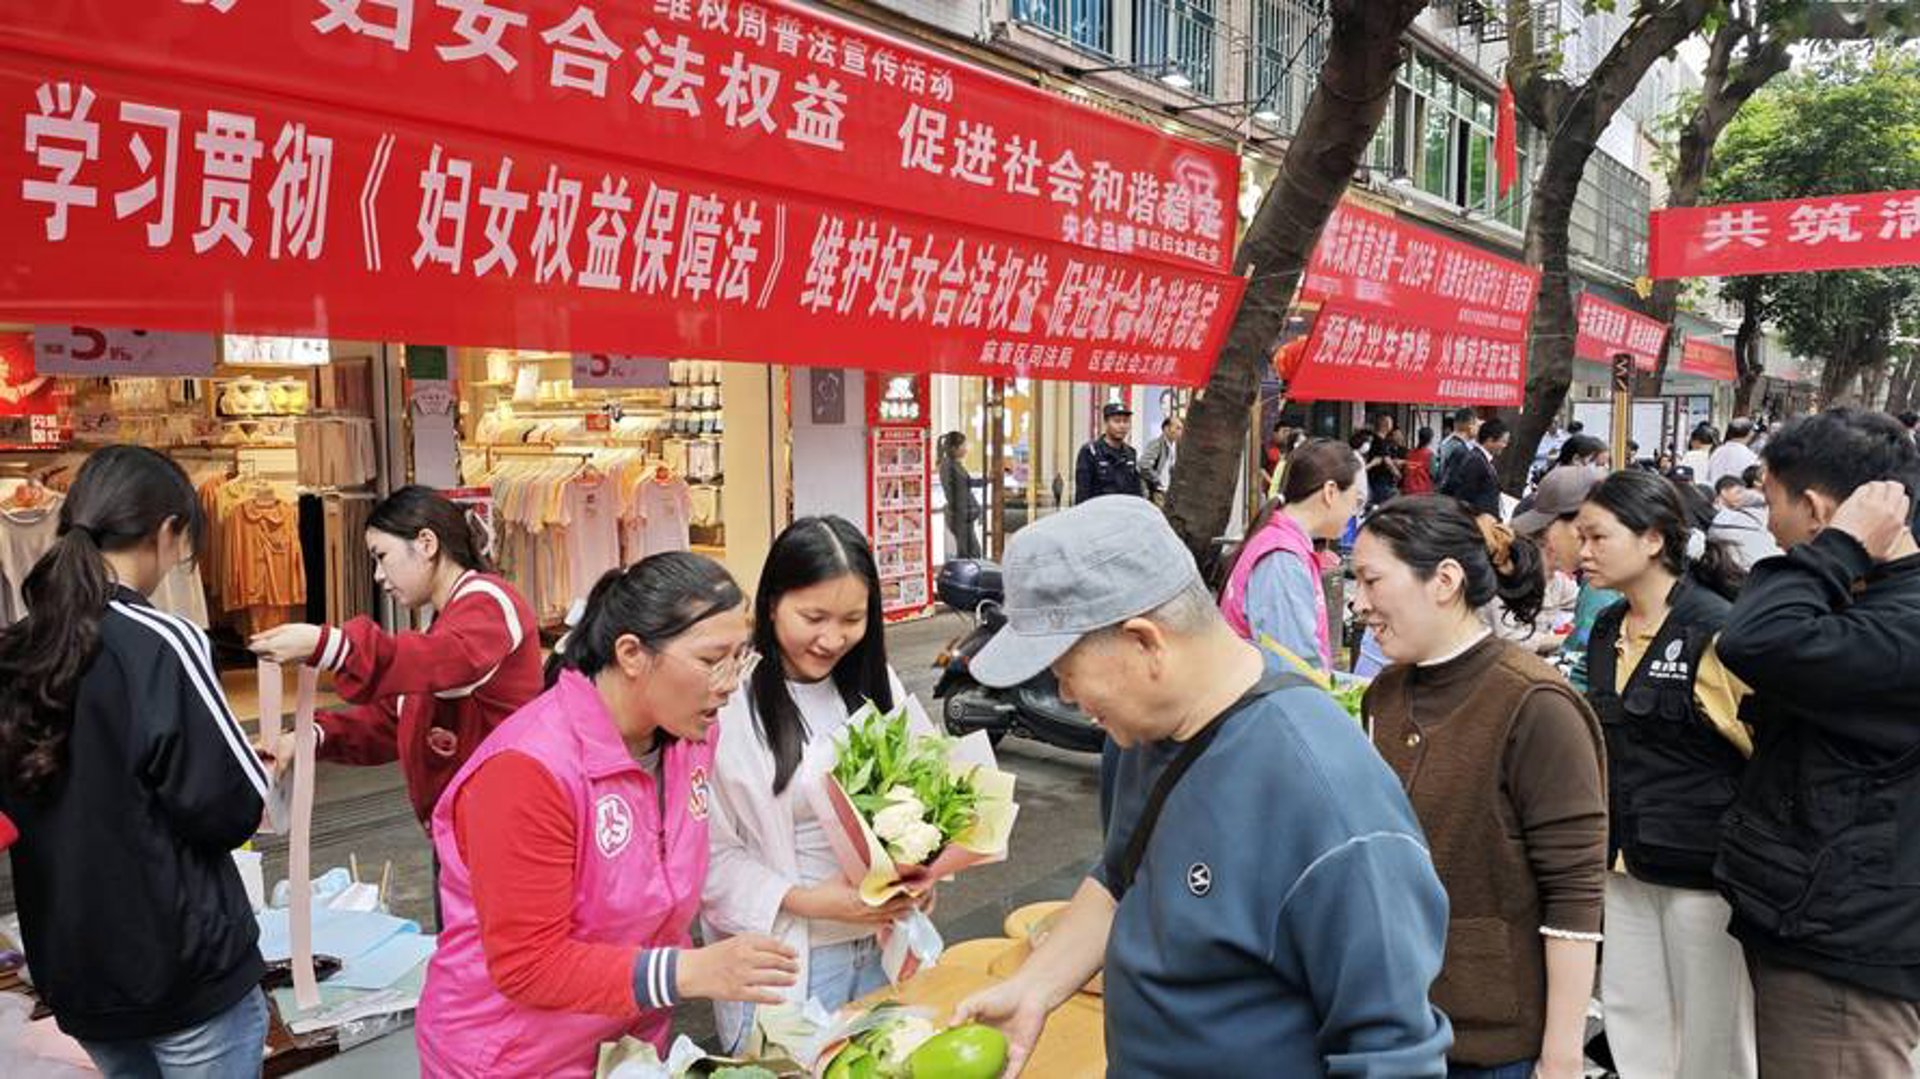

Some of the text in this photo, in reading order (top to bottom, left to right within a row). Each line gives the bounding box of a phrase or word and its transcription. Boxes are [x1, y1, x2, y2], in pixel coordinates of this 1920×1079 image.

[178, 0, 848, 150] 妇女合法权益
[653, 0, 955, 103] 维权周普法宣传活动
